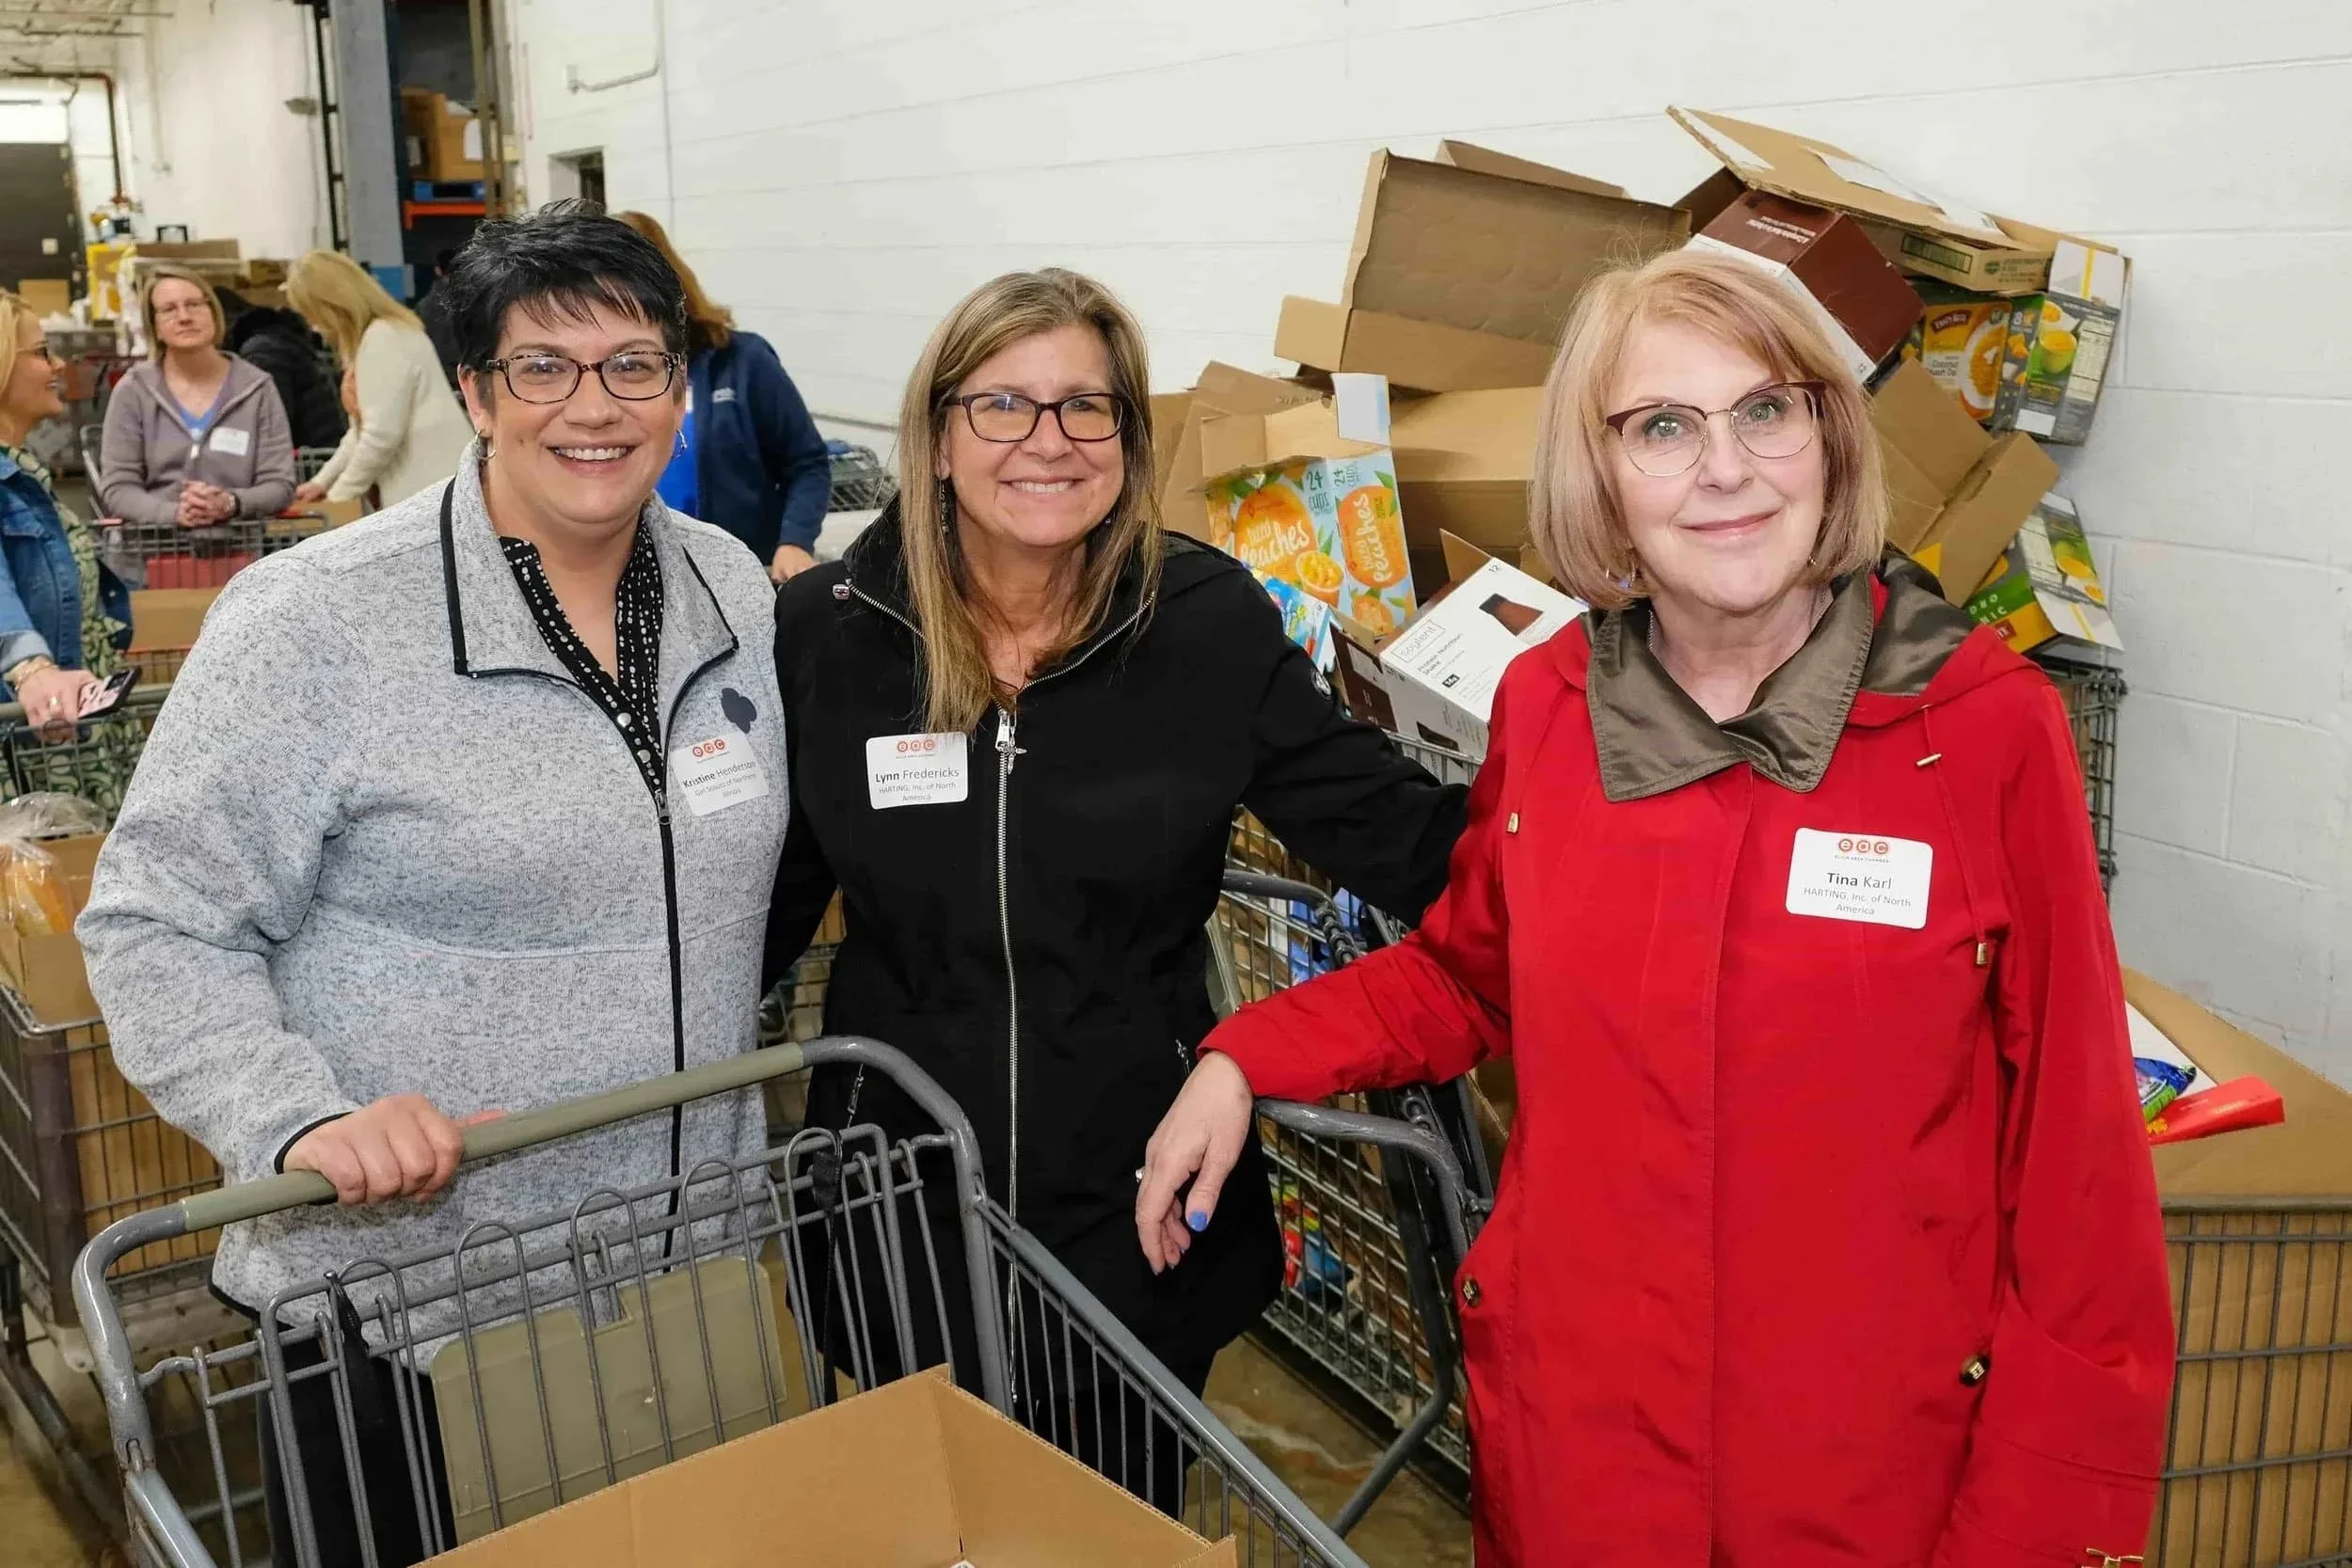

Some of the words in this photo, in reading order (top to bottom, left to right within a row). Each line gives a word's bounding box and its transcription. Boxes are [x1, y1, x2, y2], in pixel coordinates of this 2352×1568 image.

[1306, 469, 1325, 491] 24
[682, 773, 716, 788] Kristine
[716, 761, 756, 777] Henderson
[875, 772, 899, 784] Lynn
[902, 768, 960, 779] Fredericks
[935, 782, 957, 790] North
[1827, 872, 1858, 887] Tina
[1863, 876, 1892, 890] Karl
[1836, 903, 1875, 915] America
[1870, 894, 1883, 903] of
[1883, 895, 1911, 908] North
